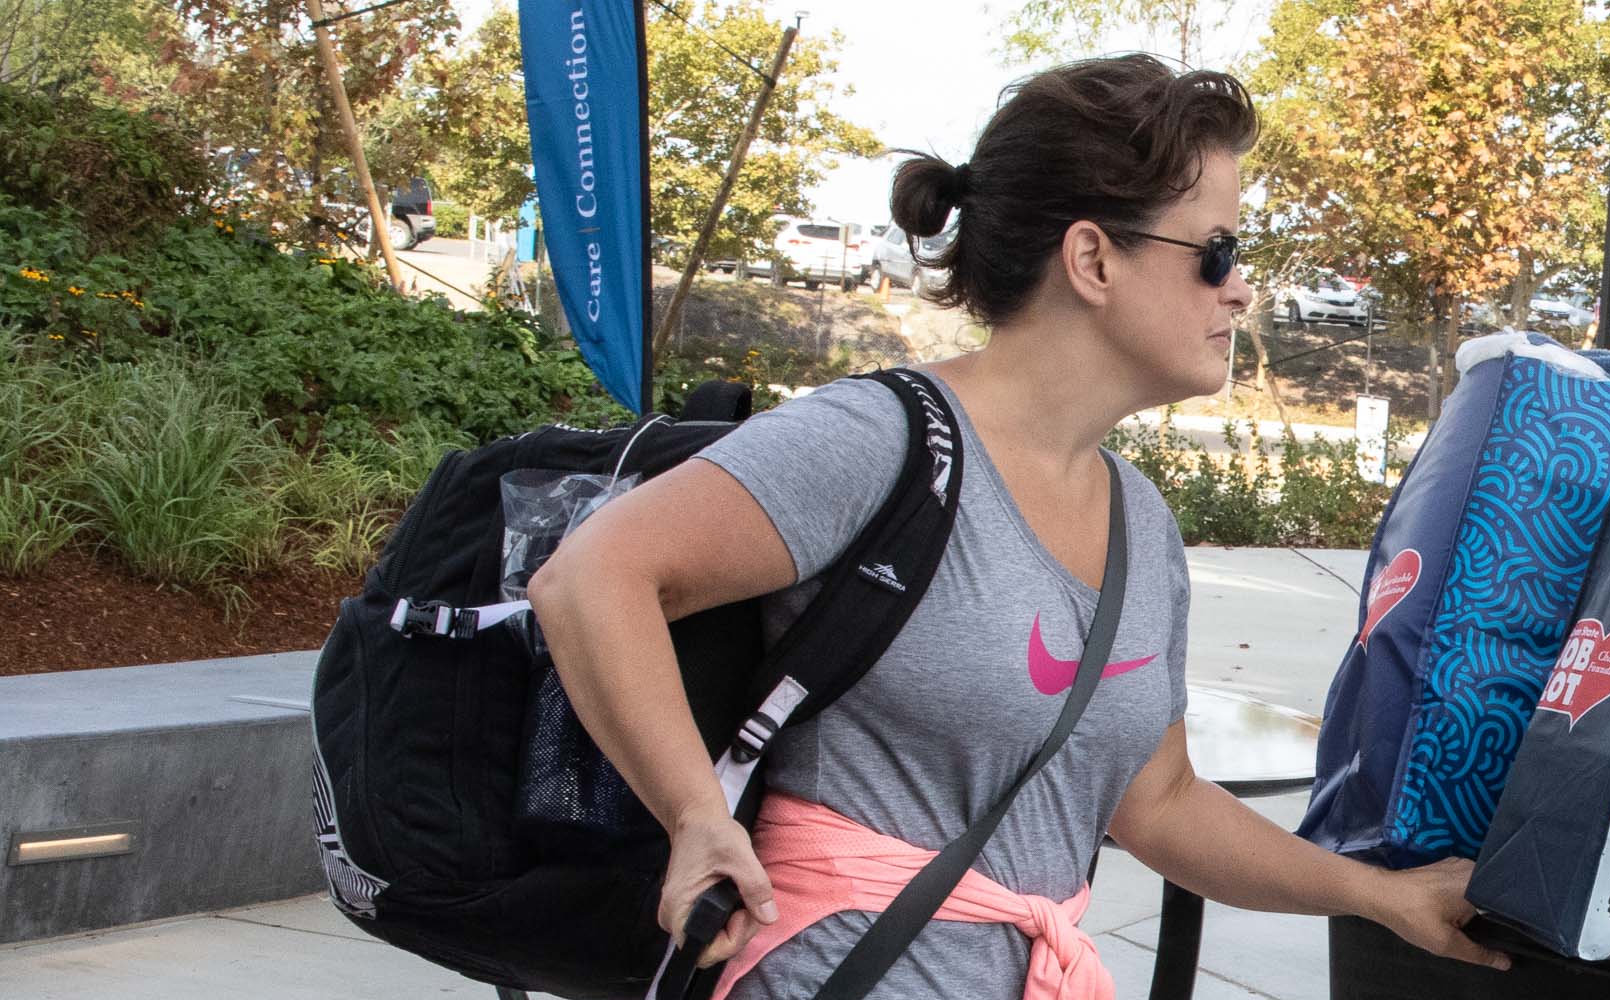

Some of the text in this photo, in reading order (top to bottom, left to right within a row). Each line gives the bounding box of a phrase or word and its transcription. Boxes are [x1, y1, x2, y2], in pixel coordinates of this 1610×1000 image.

[565, 8, 601, 323] Care Connection
[1556, 637, 1596, 672] OB
[1542, 671, 1583, 706] OT
